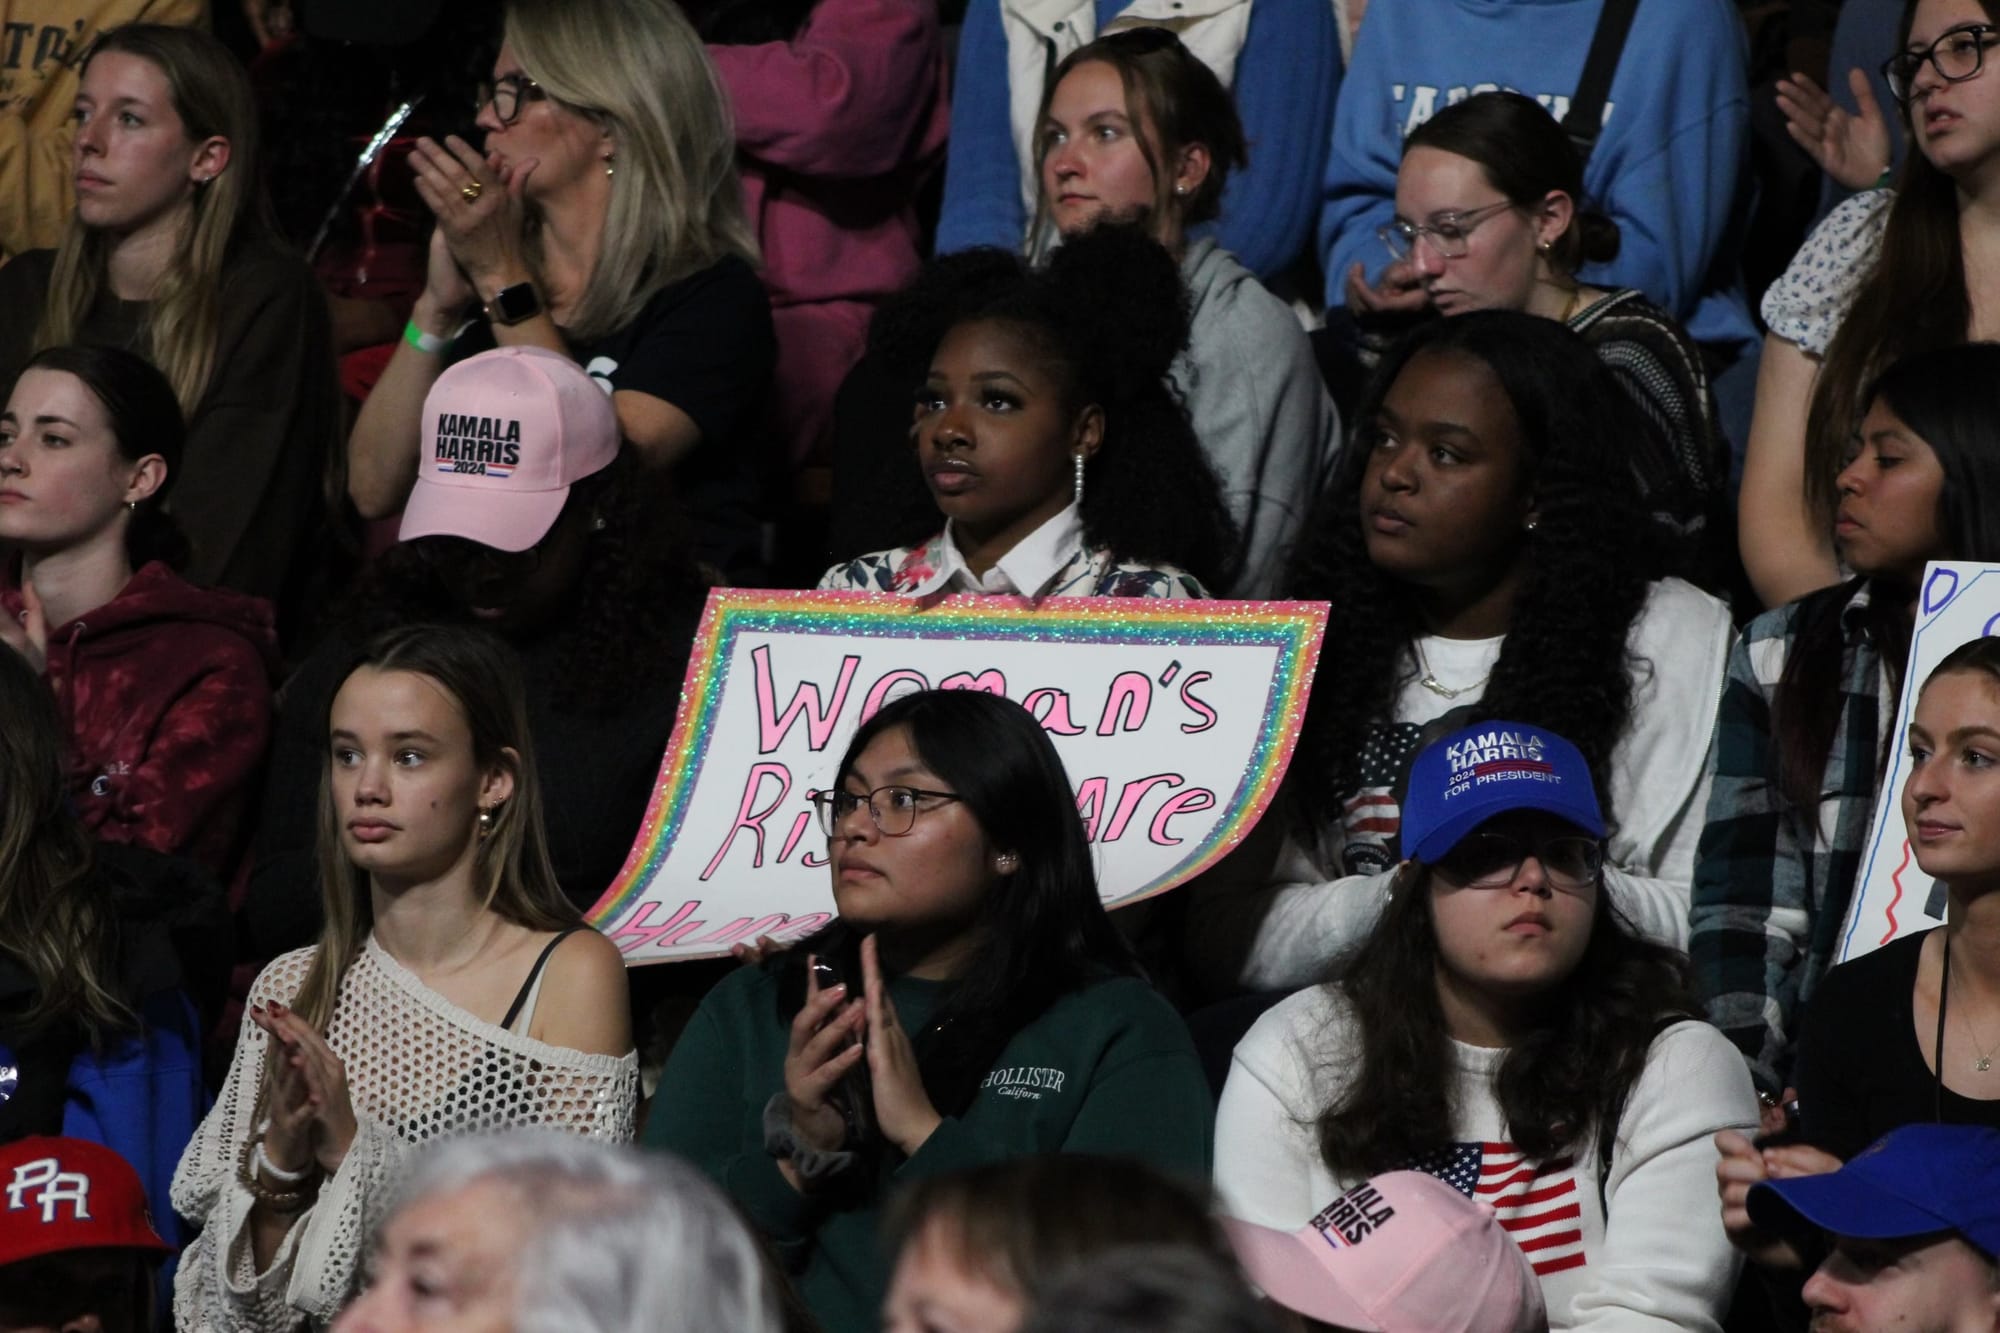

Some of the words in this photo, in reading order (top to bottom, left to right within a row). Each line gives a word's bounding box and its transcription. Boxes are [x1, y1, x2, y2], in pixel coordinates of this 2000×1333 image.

[437, 414, 520, 442] KAMALA
[435, 437, 520, 465] HARRIS
[453, 461, 486, 475] 2024
[1446, 731, 1545, 760] KAMALA
[1451, 745, 1543, 773] HARRIS
[1444, 781, 1471, 800] FOR
[1476, 770, 1562, 786] PRESIDENT
[1449, 769, 1476, 786] 2024
[980, 1067, 1065, 1093] HOLLISTER
[998, 1086, 1042, 1099] Californ
[6, 1157, 91, 1222] PR
